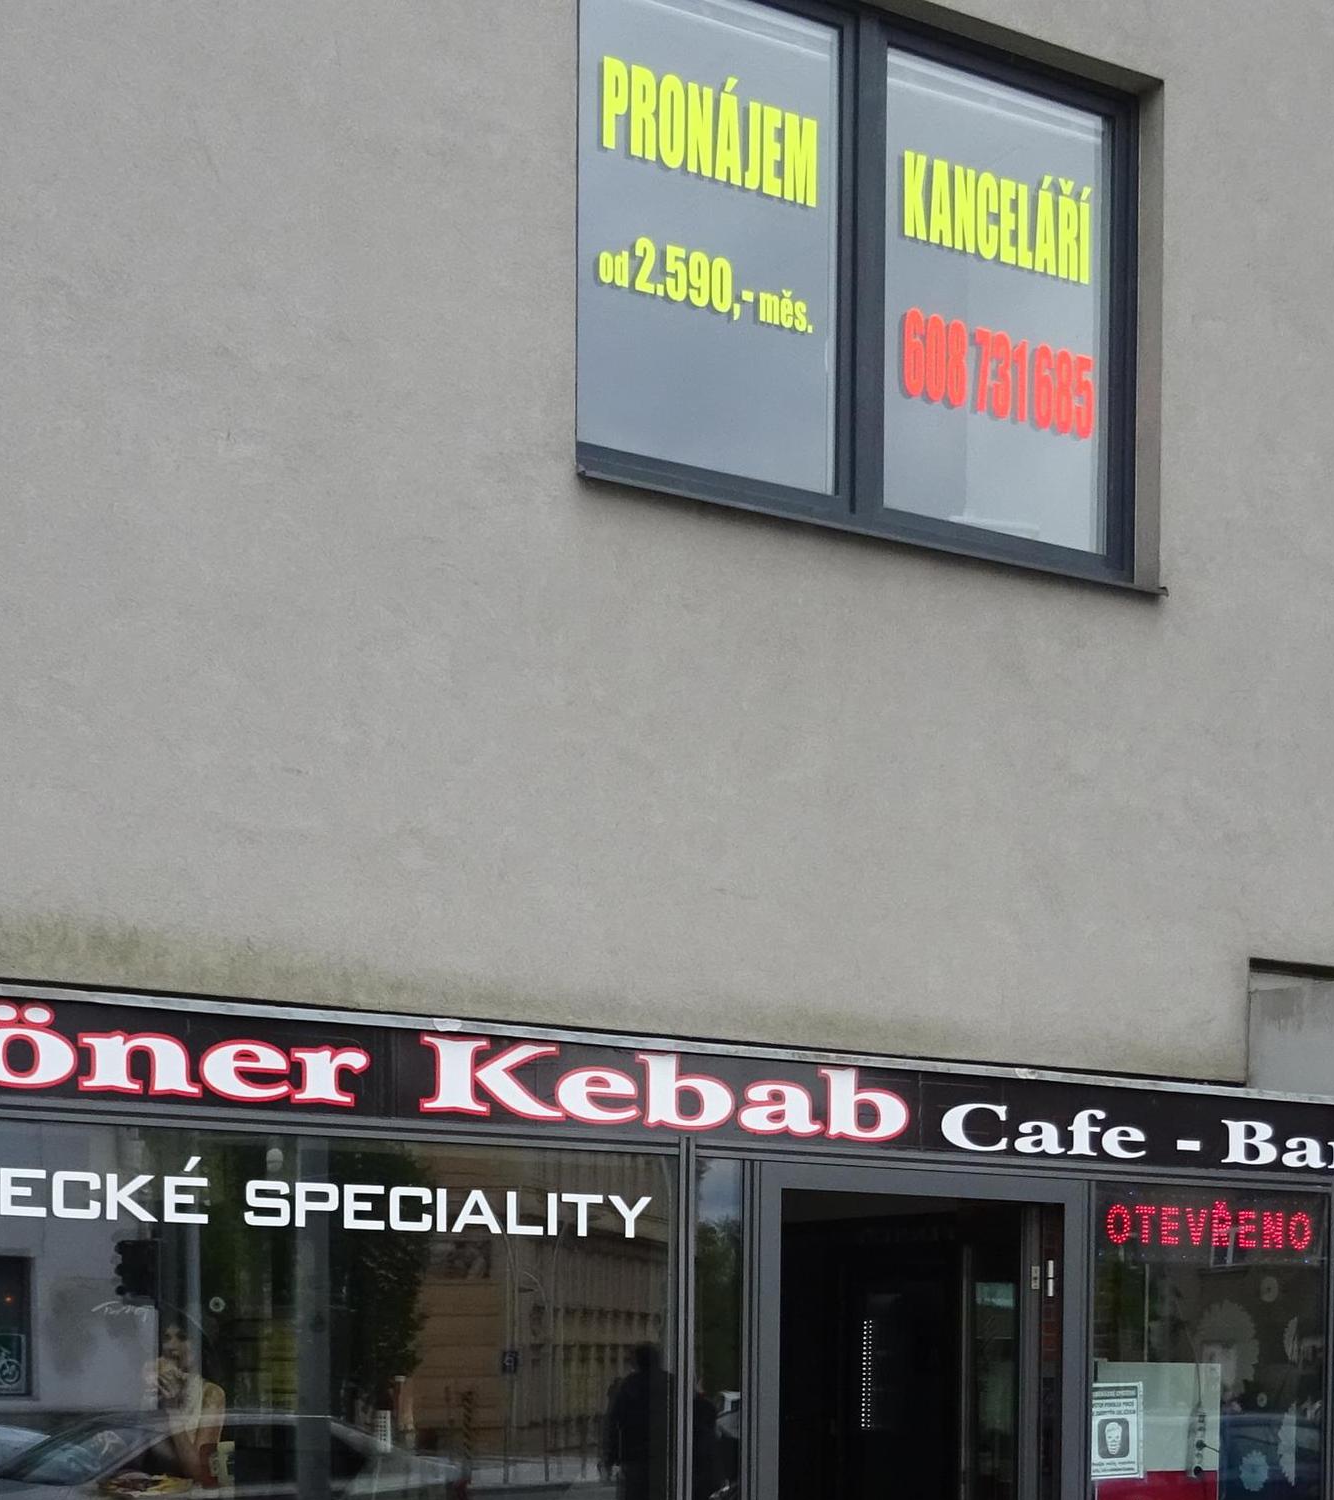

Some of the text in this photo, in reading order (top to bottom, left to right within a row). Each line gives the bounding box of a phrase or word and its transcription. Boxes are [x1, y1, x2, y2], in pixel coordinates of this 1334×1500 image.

[602, 55, 819, 208] PRONÁJEM
[903, 149, 1092, 285] KANCELÁŘÍ
[598, 250, 630, 288] od
[758, 289, 814, 333] měs.
[903, 307, 1095, 439] 608 731 685
[417, 1030, 909, 1144] Kebab
[940, 1102, 1148, 1159] Cafe
[244, 1180, 652, 1239] SPECIALITY
[1105, 1199, 1315, 1253] OTEVŘENO
